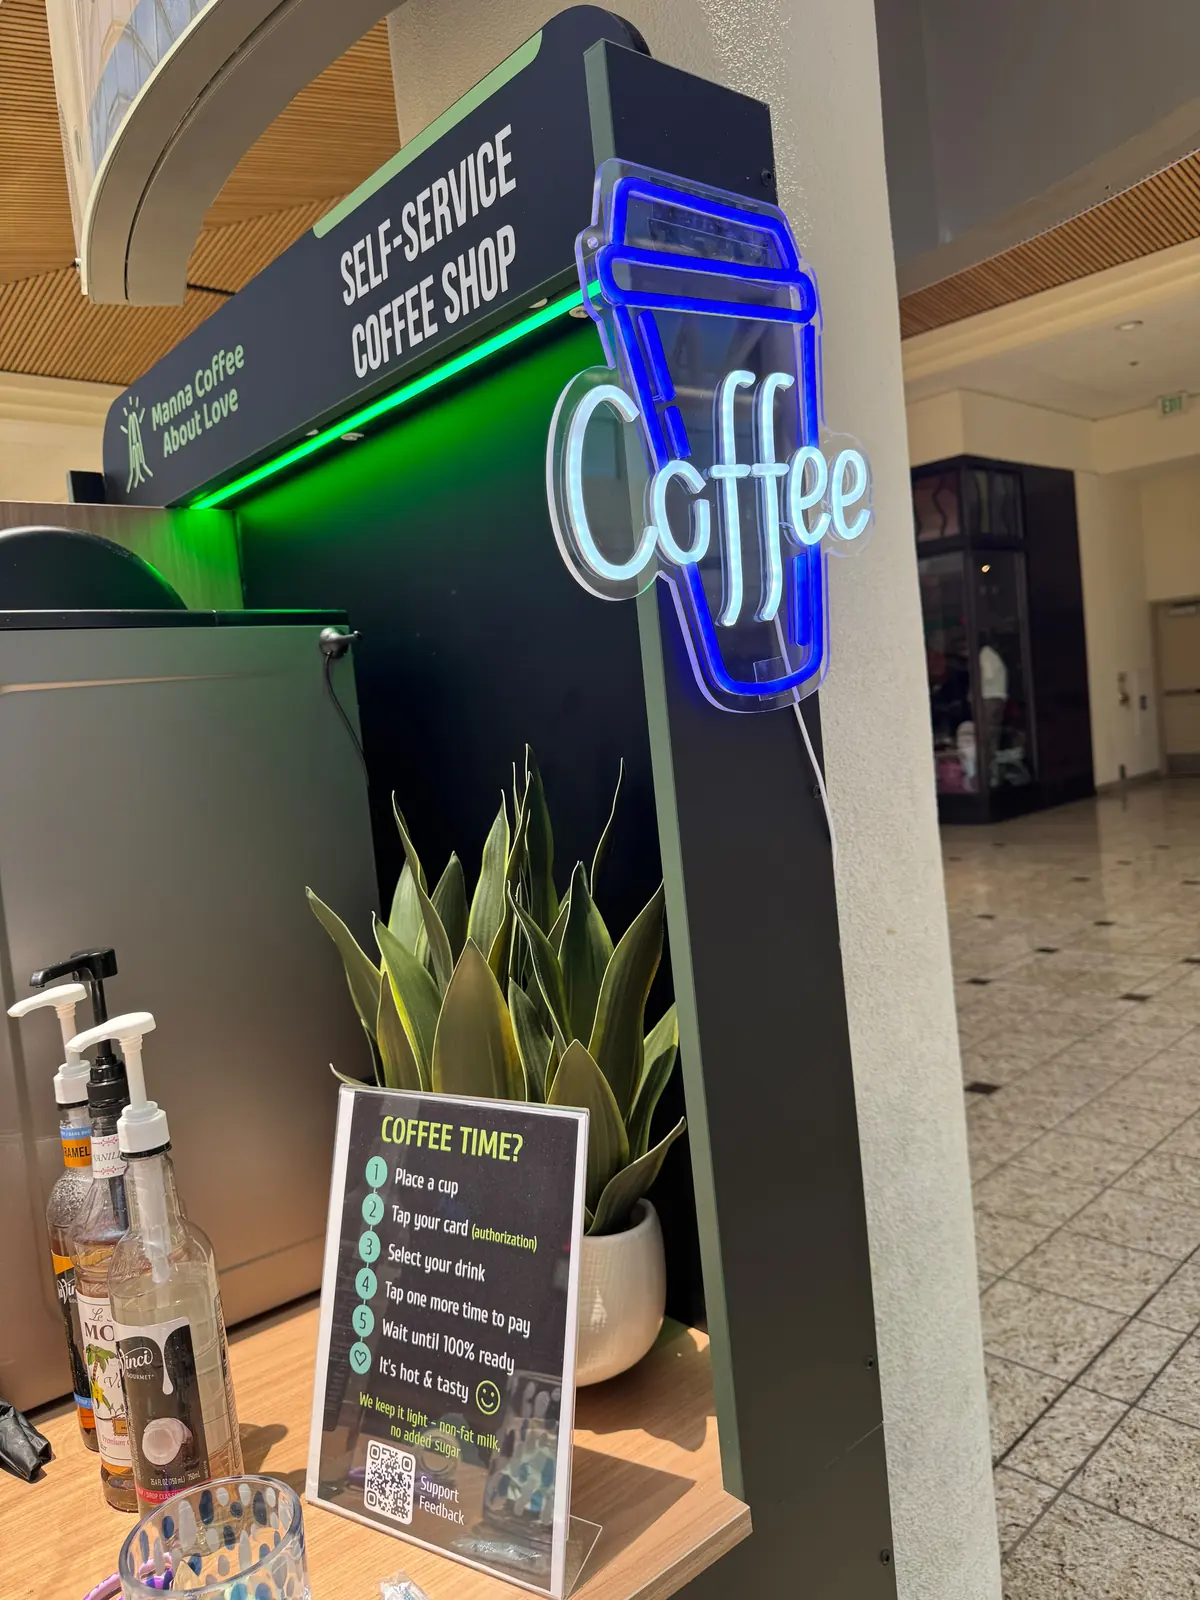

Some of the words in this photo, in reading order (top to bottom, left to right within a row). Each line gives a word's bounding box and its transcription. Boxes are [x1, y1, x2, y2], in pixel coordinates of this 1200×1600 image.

[340, 124, 517, 306] SELF-SERVICE
[351, 275, 439, 379] COFFEE
[441, 224, 517, 324] SHOP
[151, 383, 194, 432] Manna
[195, 344, 245, 398] Coffee
[163, 418, 203, 458] About
[204, 388, 239, 434] Love
[566, 369, 870, 627] Coffee
[381, 1115, 454, 1152] COFFEE
[460, 1126, 524, 1163] TIME?
[395, 1167, 424, 1189] Place
[427, 1176, 435, 1191] a
[438, 1179, 459, 1198] cup
[368, 1200, 377, 1219] 2
[392, 1205, 411, 1225] Tap
[413, 1214, 441, 1233] your
[443, 1218, 469, 1237] card
[471, 1223, 538, 1253] (authorization)
[364, 1238, 373, 1256] 3
[388, 1243, 422, 1268] Select
[424, 1253, 452, 1274] your
[455, 1258, 486, 1283] drink
[361, 1275, 370, 1293] 4
[385, 1280, 404, 1302] Tap
[406, 1290, 427, 1308] one
[430, 1295, 459, 1316] more
[462, 1300, 489, 1324] time
[491, 1308, 505, 1328] to
[507, 1316, 531, 1339] pay
[359, 1312, 367, 1330] 5
[382, 1318, 408, 1343] Wait
[411, 1327, 440, 1350] until
[443, 1334, 475, 1362] 100%
[479, 1347, 515, 1376] ready
[379, 1356, 397, 1378] It's
[400, 1364, 420, 1385] hot
[423, 1370, 433, 1389] &
[437, 1375, 469, 1403] tasty
[359, 1391, 373, 1409] We
[375, 1395, 396, 1418] keep
[397, 1400, 405, 1420] it
[406, 1405, 429, 1428] light
[439, 1419, 474, 1443] non-fat
[477, 1431, 502, 1453] milk,
[390, 1423, 402, 1439] no
[403, 1427, 432, 1449] added
[434, 1439, 461, 1460] sugar
[419, 1494, 465, 1526] Feedback
[420, 1475, 460, 1503] Support
